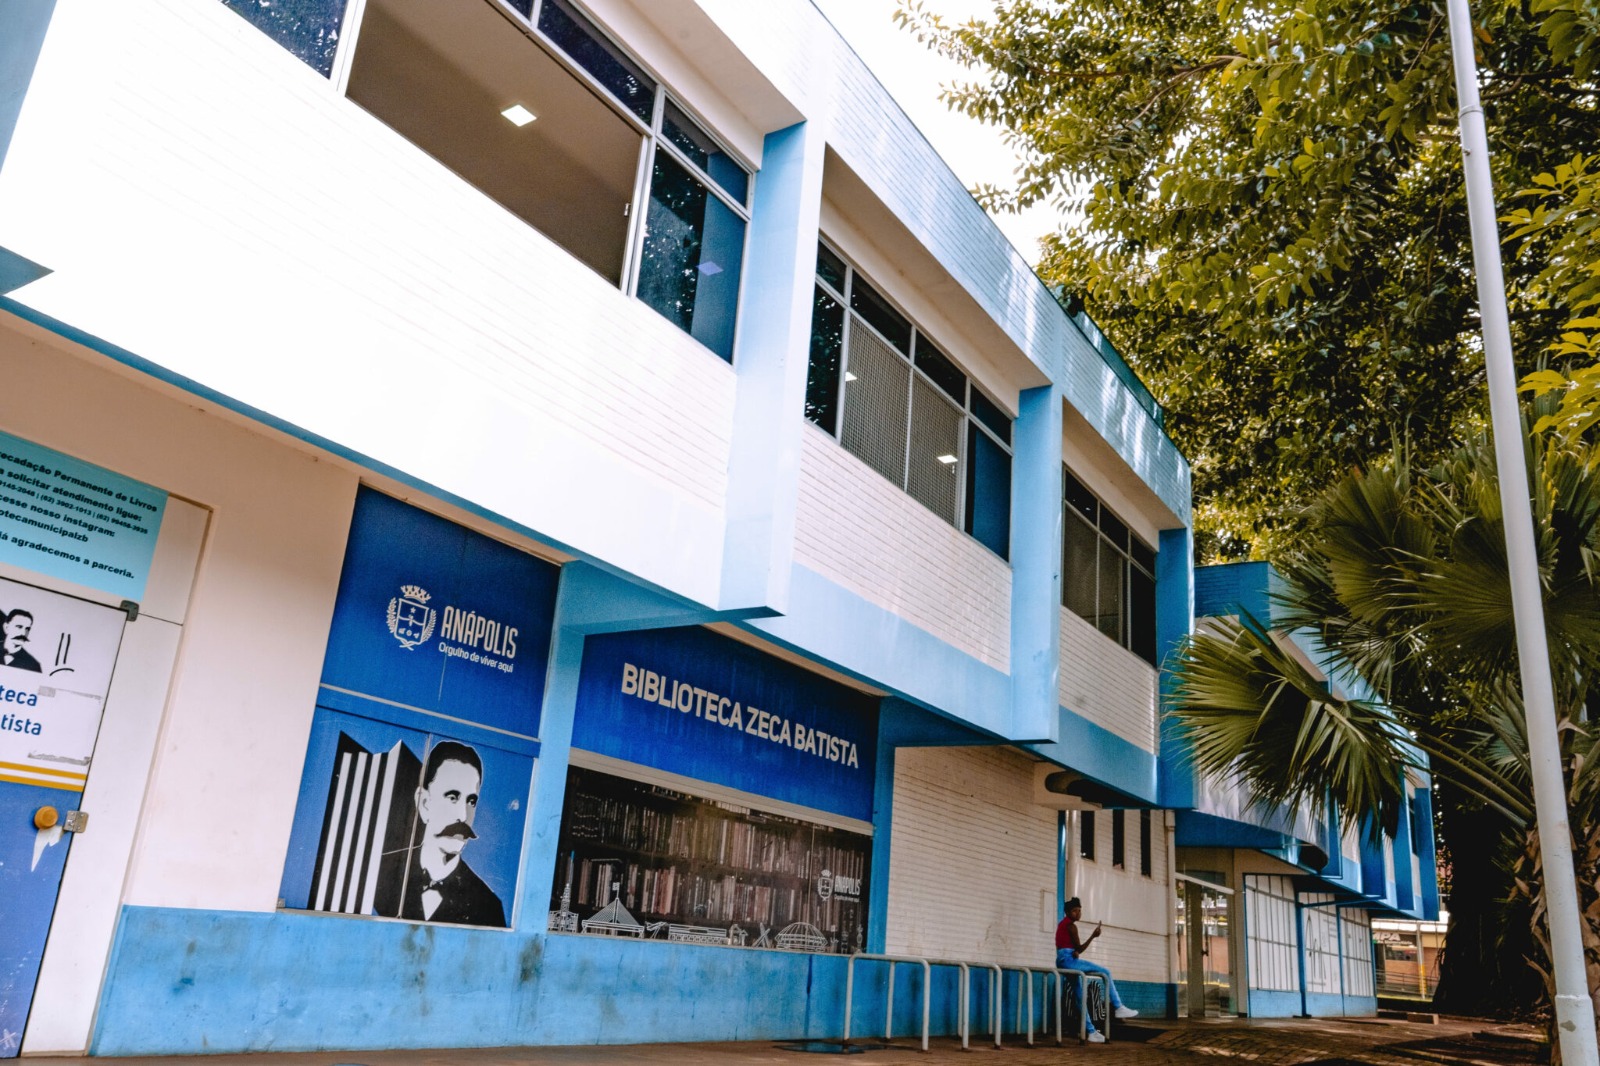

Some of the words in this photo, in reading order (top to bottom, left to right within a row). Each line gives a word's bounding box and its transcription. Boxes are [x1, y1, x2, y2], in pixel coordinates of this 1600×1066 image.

[0, 452, 52, 475] ecadação
[54, 470, 113, 497] Permanente
[115, 492, 127, 502] de
[129, 496, 157, 512] Livros
[7, 471, 51, 490] solicitar
[52, 487, 114, 512] atendimento
[116, 507, 142, 522] ligue:
[30, 505, 61, 519] nosso
[63, 514, 116, 537] instagram:
[11, 536, 81, 562] agradecemos
[91, 561, 135, 579] parceria.
[440, 605, 519, 659] ANÁPOLIS
[439, 642, 469, 660] Orgulho
[469, 652, 480, 663] de
[480, 655, 498, 668] viver
[498, 662, 514, 673] aqui
[0, 685, 38, 707] teca
[621, 662, 743, 731] BIBLIOTECA
[745, 706, 792, 747] ZECA
[794, 723, 859, 769] BATISTA
[1, 714, 42, 736] tista
